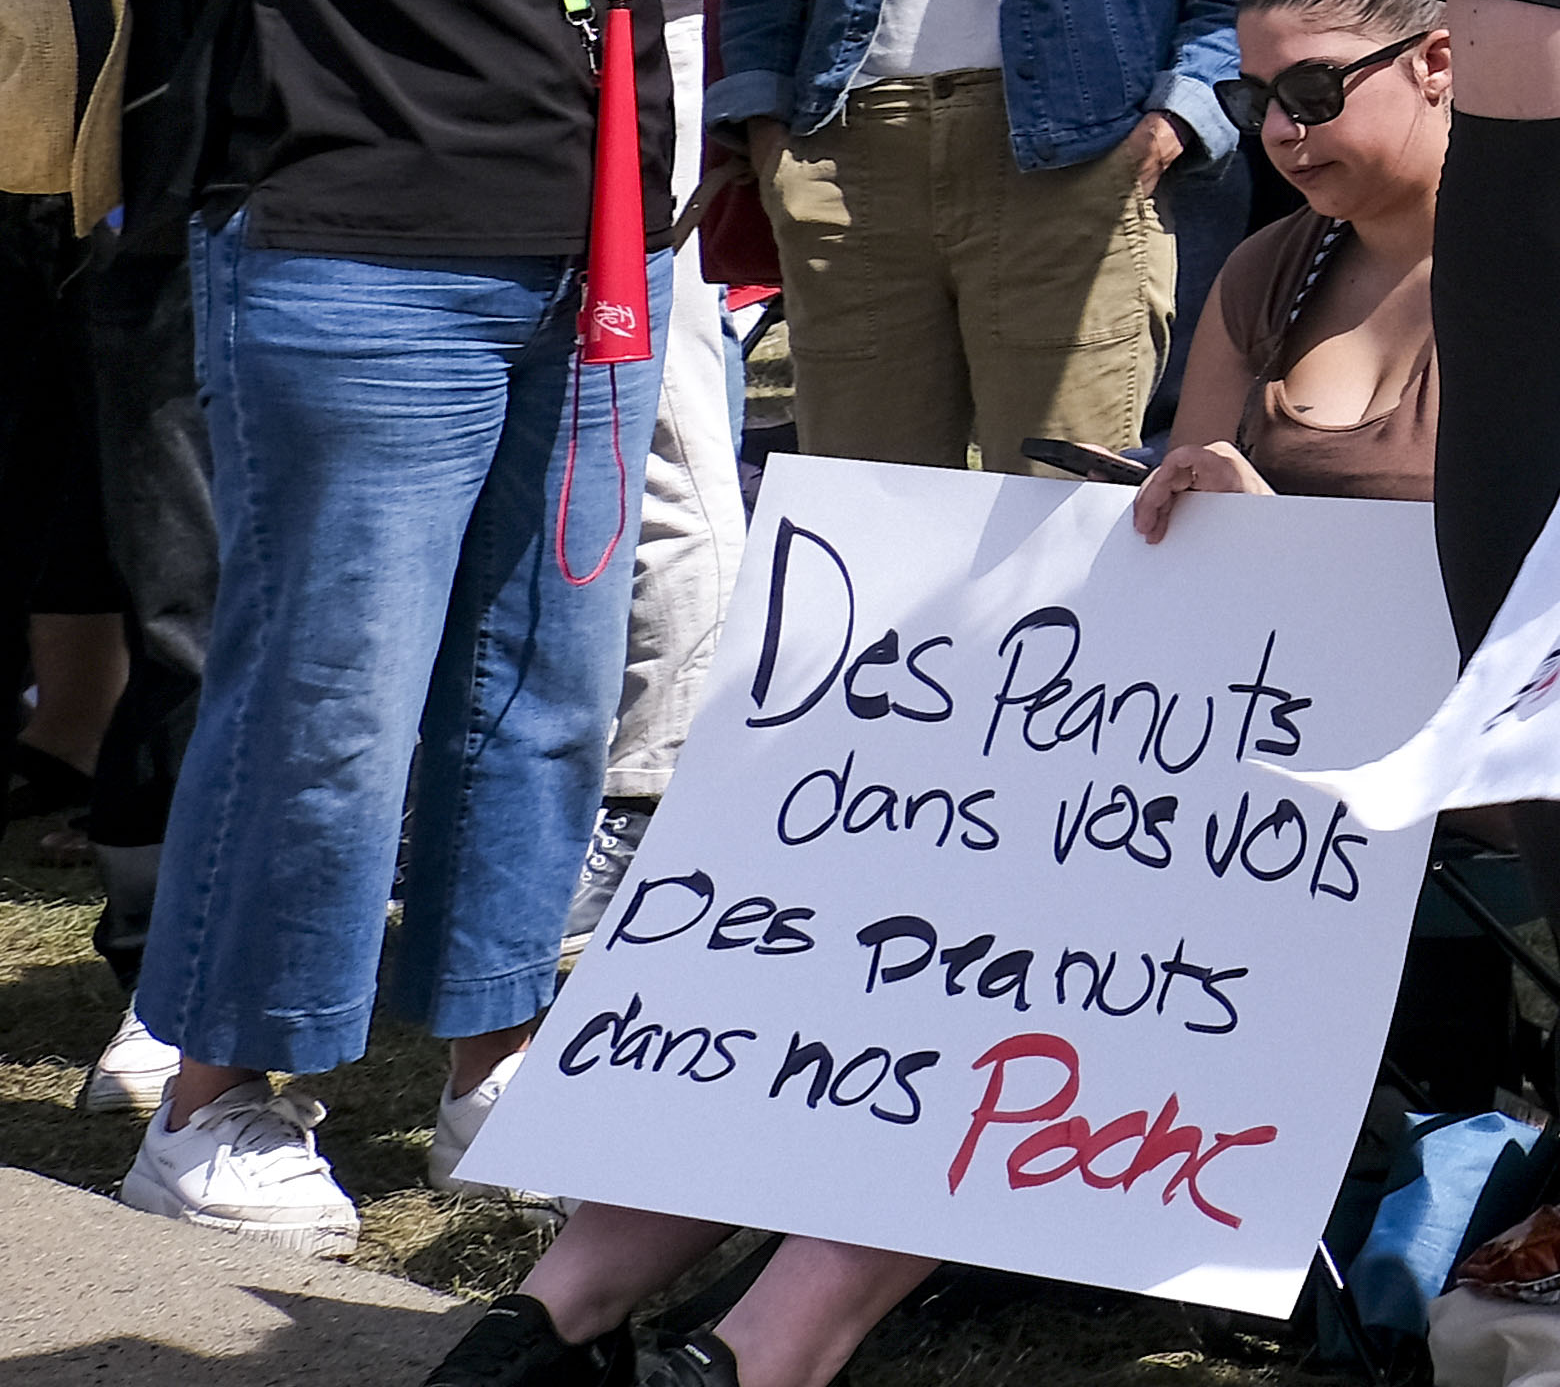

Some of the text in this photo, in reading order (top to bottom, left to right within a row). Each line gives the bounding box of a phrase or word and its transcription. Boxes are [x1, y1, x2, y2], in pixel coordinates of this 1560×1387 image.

[745, 516, 1314, 776] Des Peanuts
[778, 751, 1000, 853] dans
[1055, 780, 1179, 870] vos
[606, 869, 816, 956] Des
[559, 993, 758, 1084] dans
[769, 1032, 940, 1126] nos
